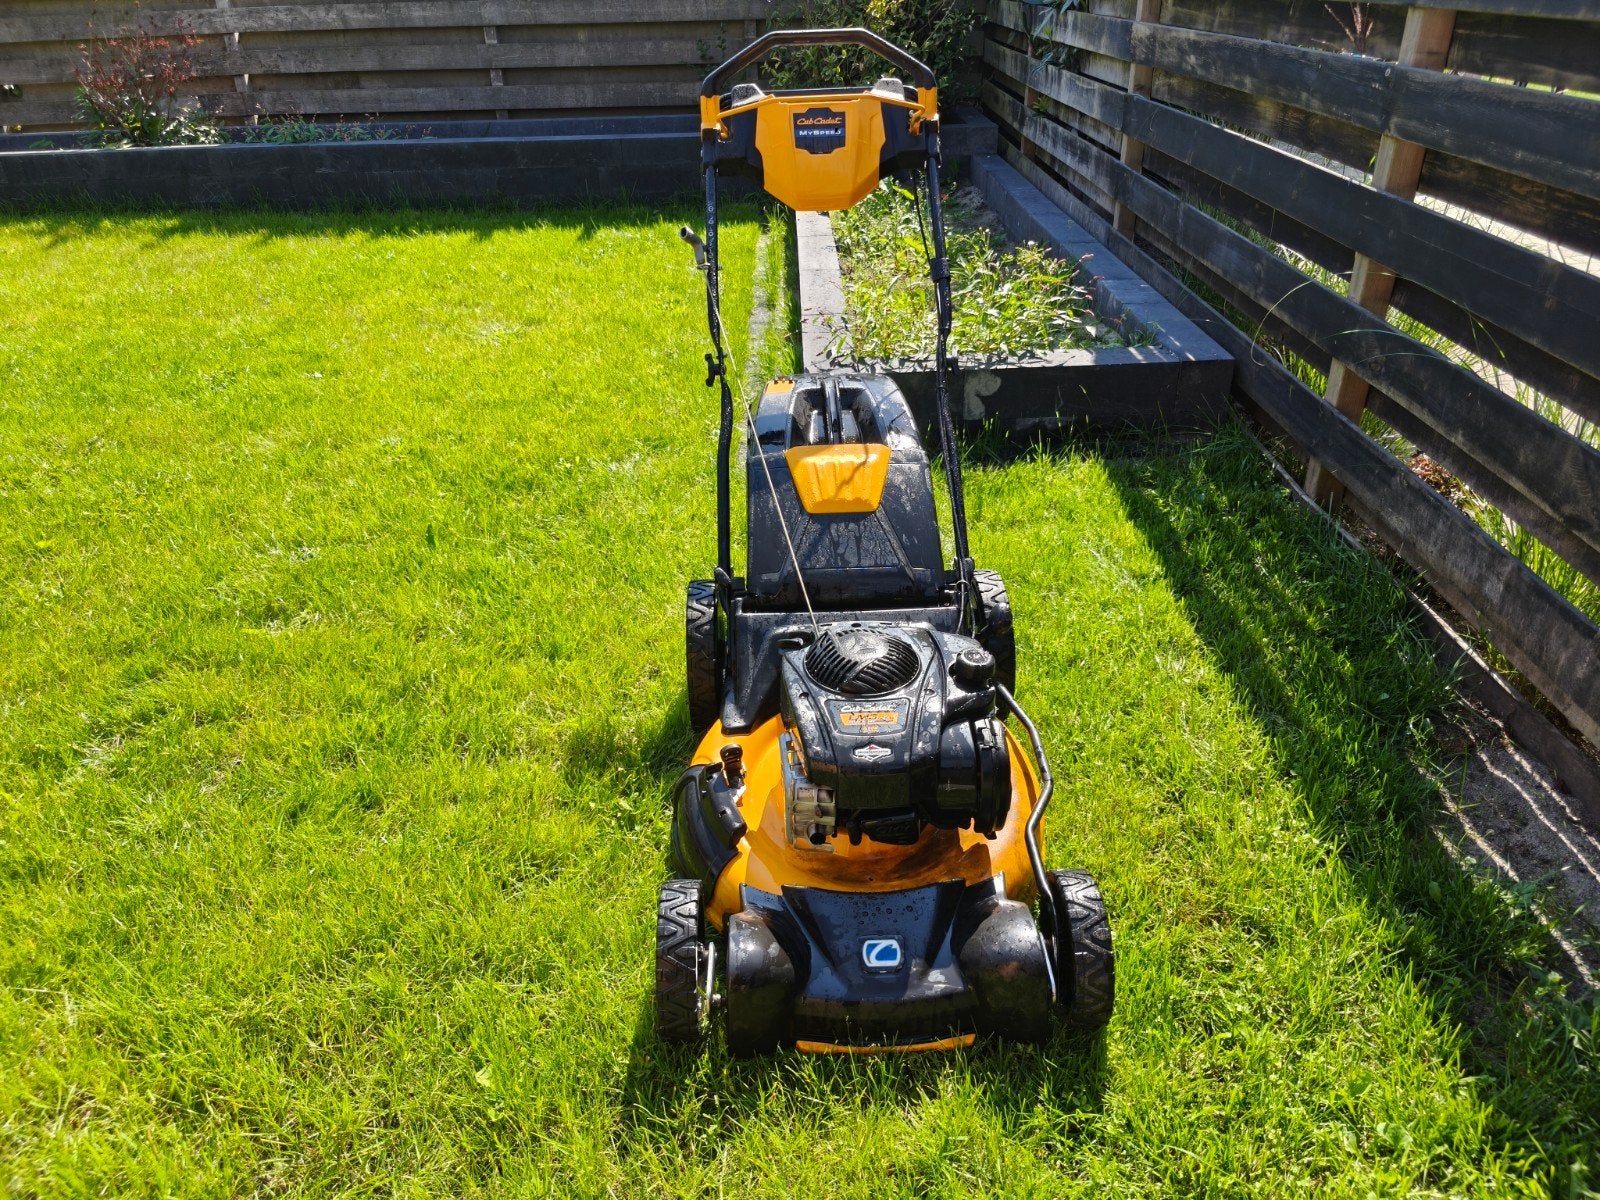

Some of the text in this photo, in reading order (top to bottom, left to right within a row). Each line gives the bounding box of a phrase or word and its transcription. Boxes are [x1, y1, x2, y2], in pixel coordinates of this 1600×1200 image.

[797, 117, 842, 125] Cub Cadet
[840, 705, 861, 713] Cub
